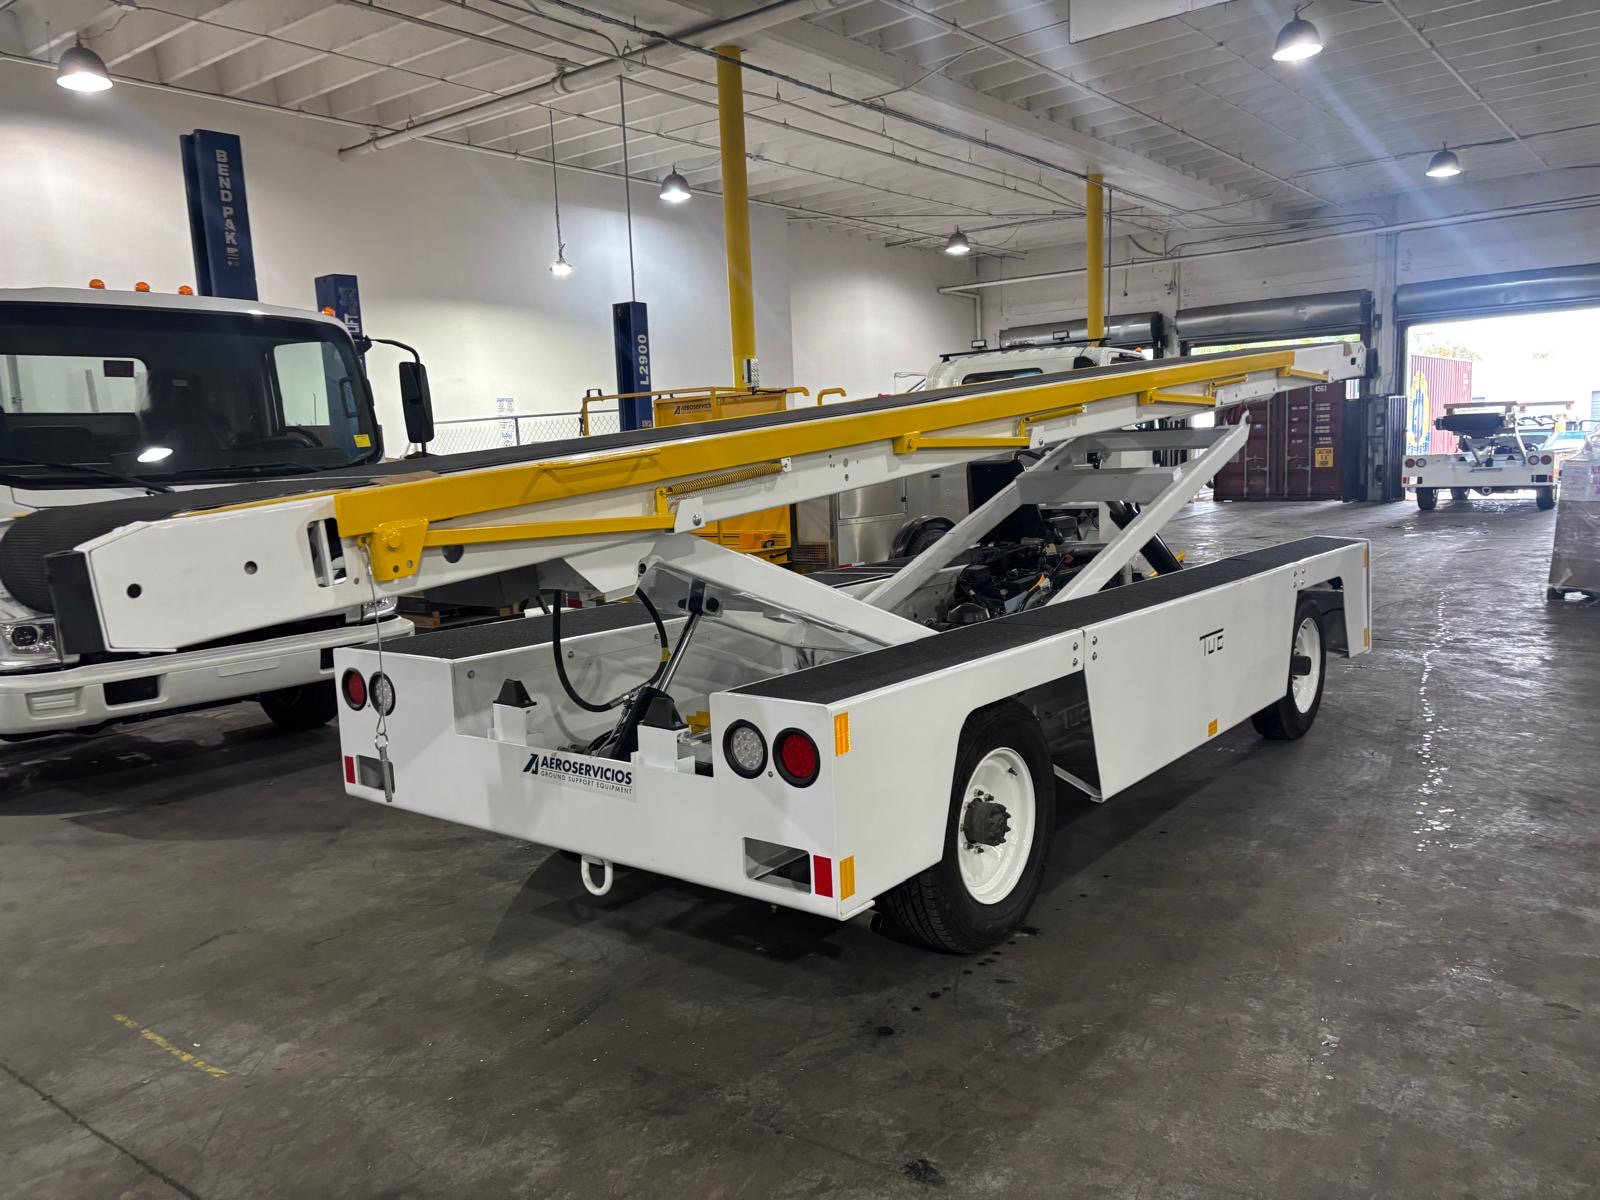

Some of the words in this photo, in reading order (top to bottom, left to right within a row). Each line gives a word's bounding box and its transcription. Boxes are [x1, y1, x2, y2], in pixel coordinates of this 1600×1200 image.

[637, 334, 649, 385] L2900
[1199, 628, 1225, 657] TUG
[540, 756, 632, 785] AEROSERVICIOS
[540, 770, 566, 781] GROUND
[568, 775, 594, 787] SUPPORT
[596, 781, 632, 794] EQUIPMENT
